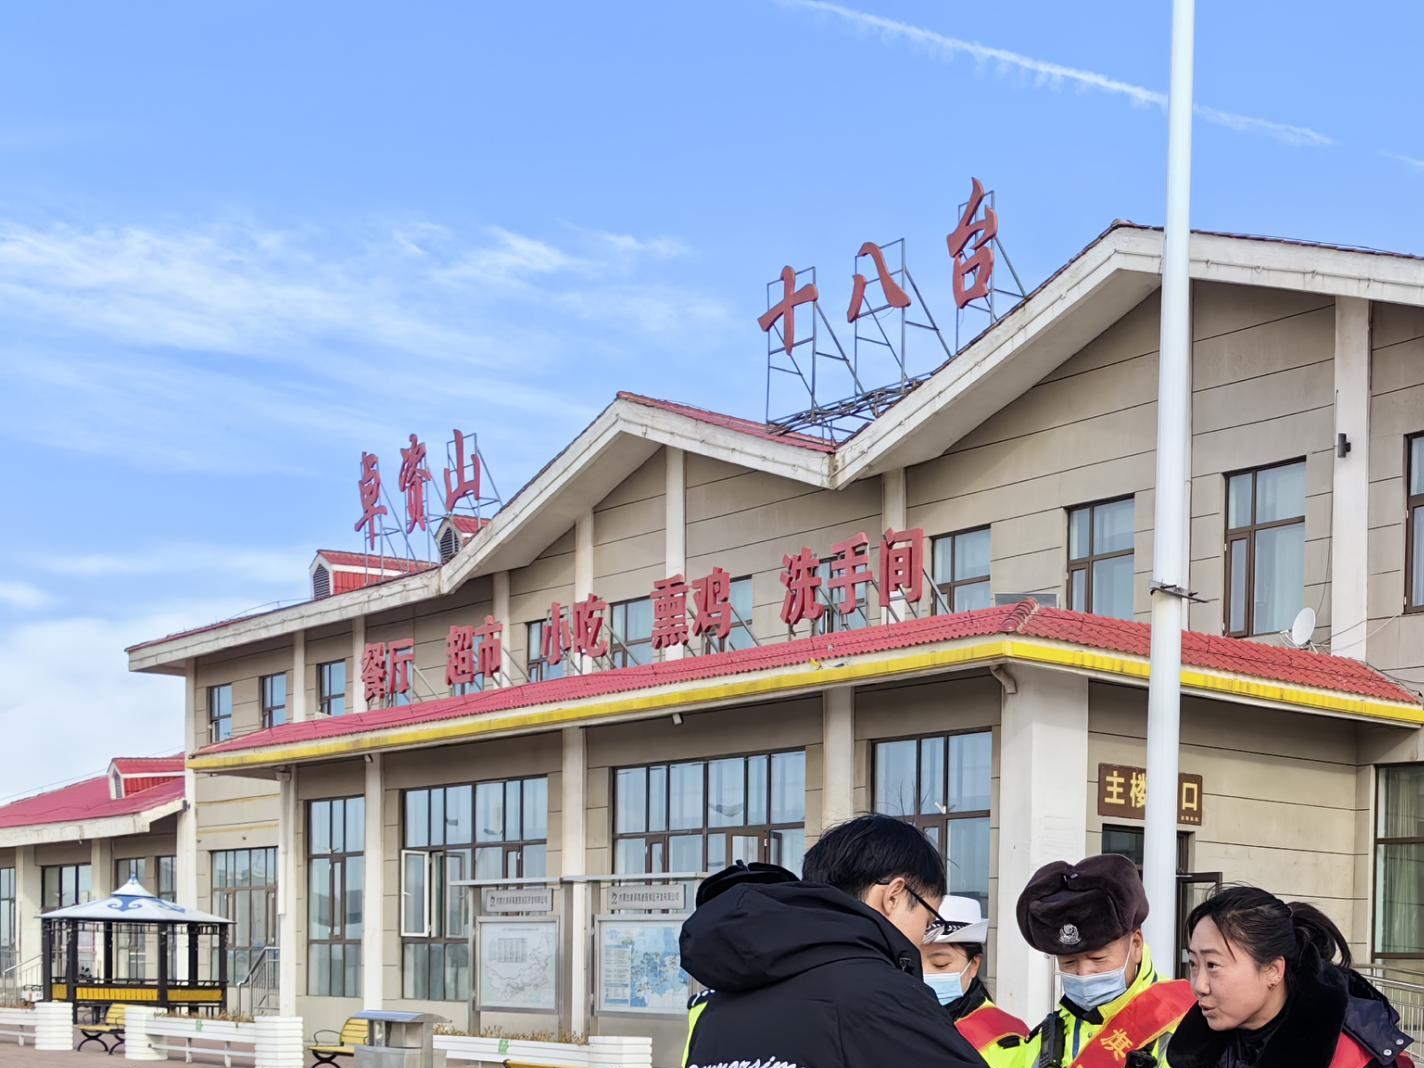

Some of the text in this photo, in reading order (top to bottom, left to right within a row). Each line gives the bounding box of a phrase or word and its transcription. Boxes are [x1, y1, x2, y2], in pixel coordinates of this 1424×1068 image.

[757, 176, 999, 357] 十八台
[354, 428, 481, 550] 卓资山
[445, 615, 503, 686] 超市
[540, 592, 608, 666] 小吃
[650, 567, 732, 650] 熏鸡
[779, 527, 925, 624] 洗手间
[1103, 770, 1199, 812] 主楼口
